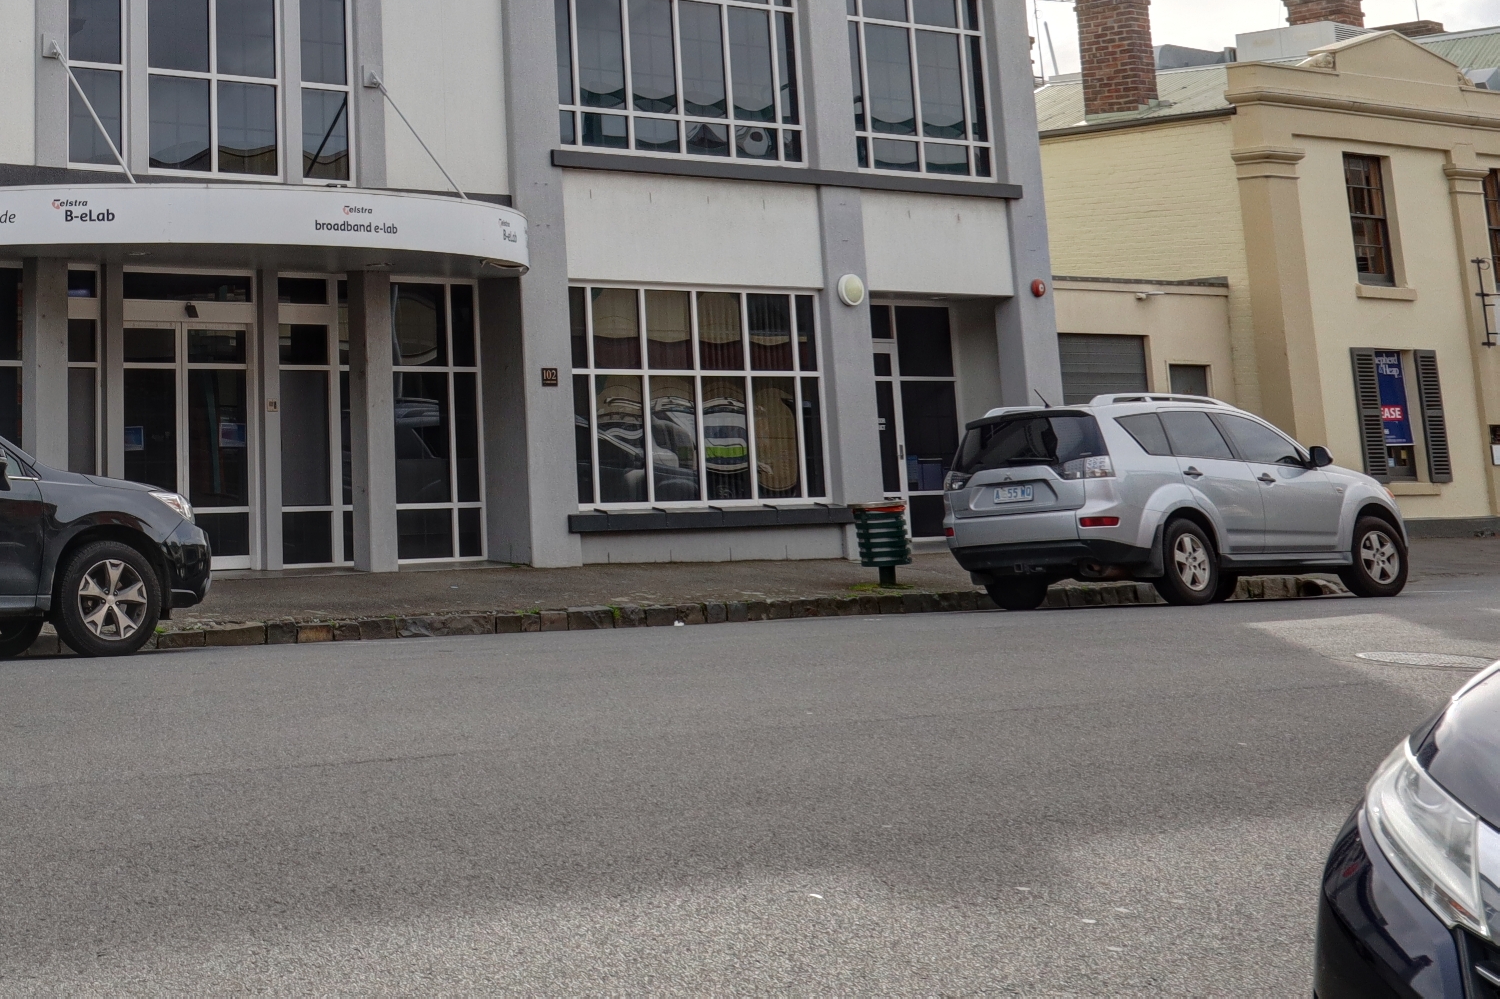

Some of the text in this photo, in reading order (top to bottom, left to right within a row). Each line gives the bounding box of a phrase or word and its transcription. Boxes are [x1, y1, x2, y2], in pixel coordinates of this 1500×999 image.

[51, 199, 88, 210] Telstra
[342, 205, 373, 215] Telstra
[64, 209, 116, 222] B-eLab
[314, 219, 398, 235] broadband e-lab
[542, 369, 557, 380] 102
